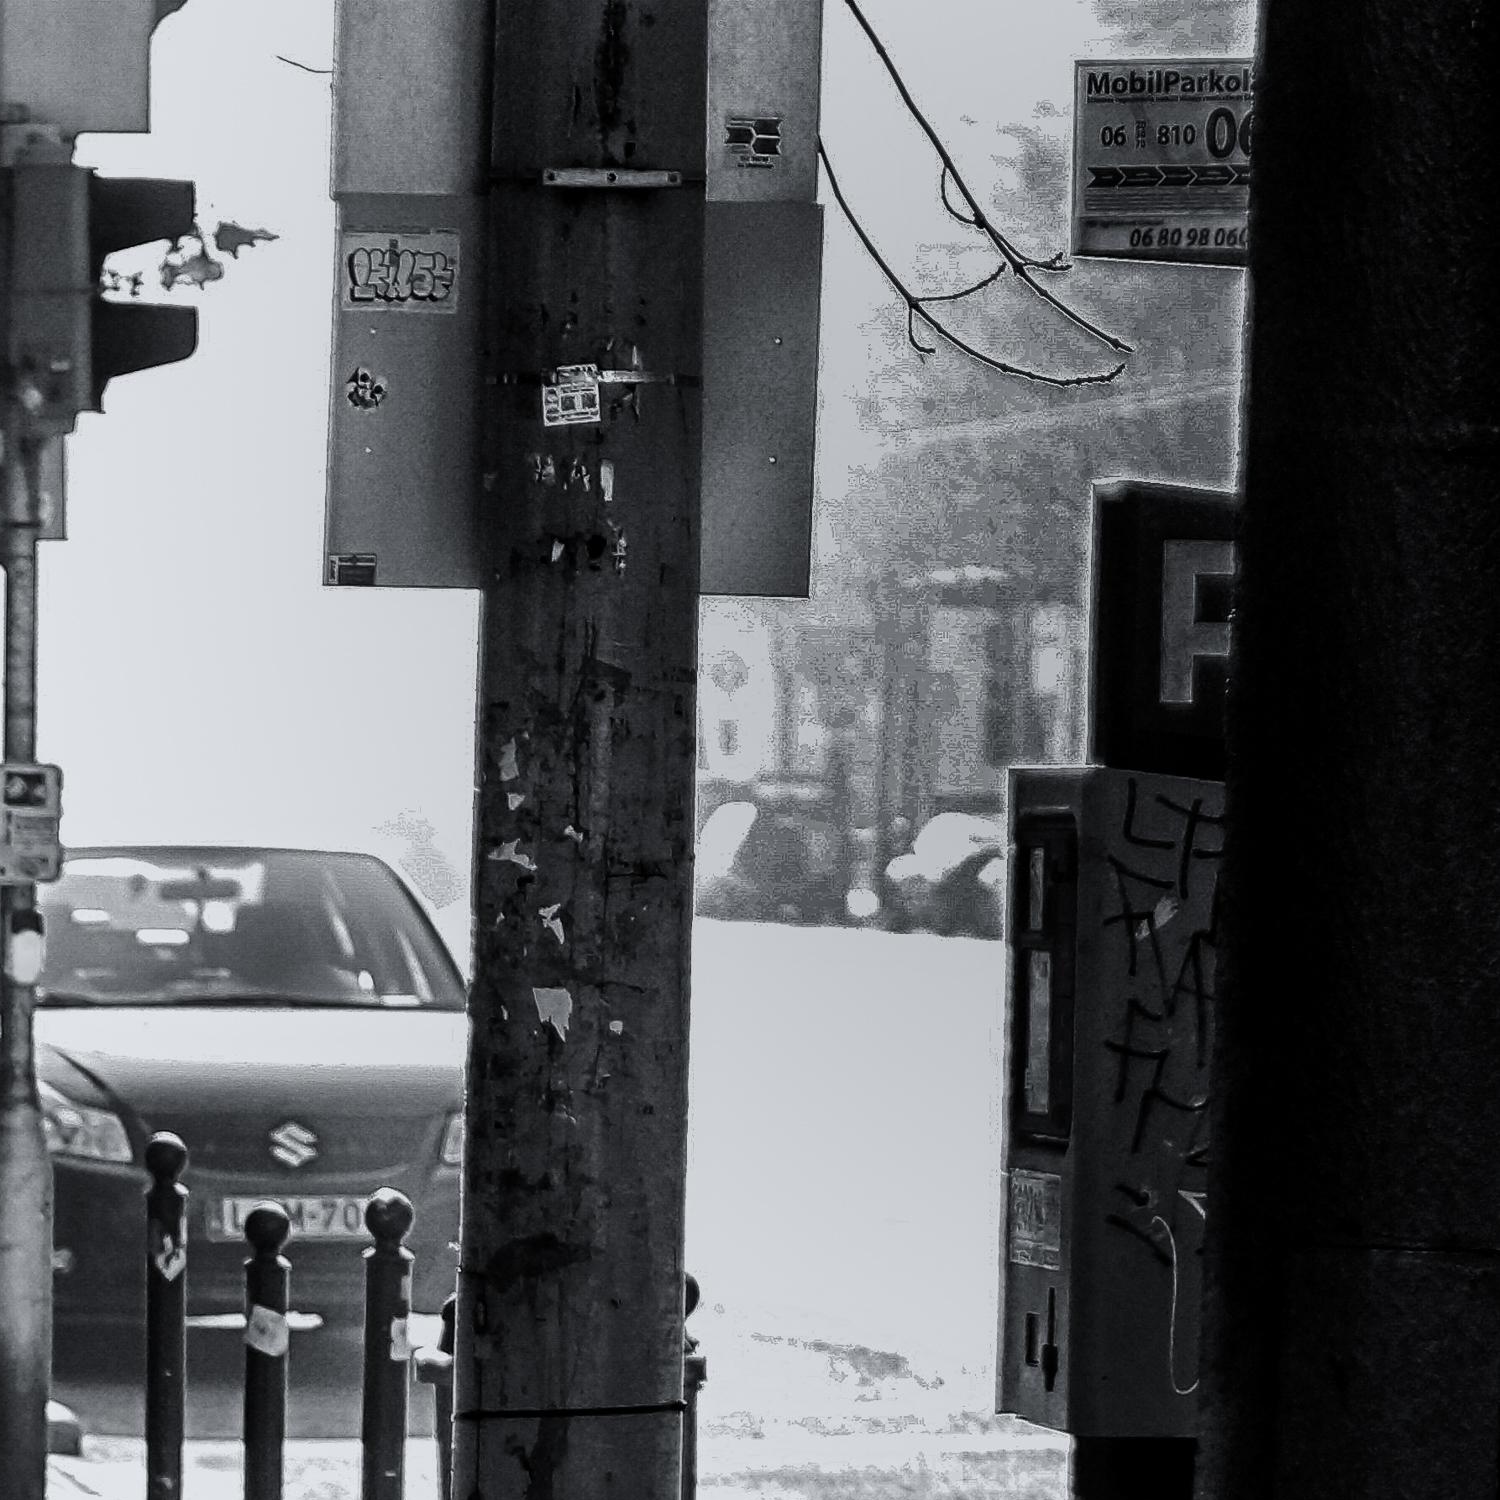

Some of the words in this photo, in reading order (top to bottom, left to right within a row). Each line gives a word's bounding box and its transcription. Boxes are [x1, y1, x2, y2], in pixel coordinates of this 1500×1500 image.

[1087, 69, 1251, 94] MobilParkol
[1101, 126, 1127, 147] 06
[1157, 124, 1196, 145] 810
[1130, 228, 1153, 247] 06
[1157, 228, 1182, 247] 80
[1187, 228, 1210, 246] 98
